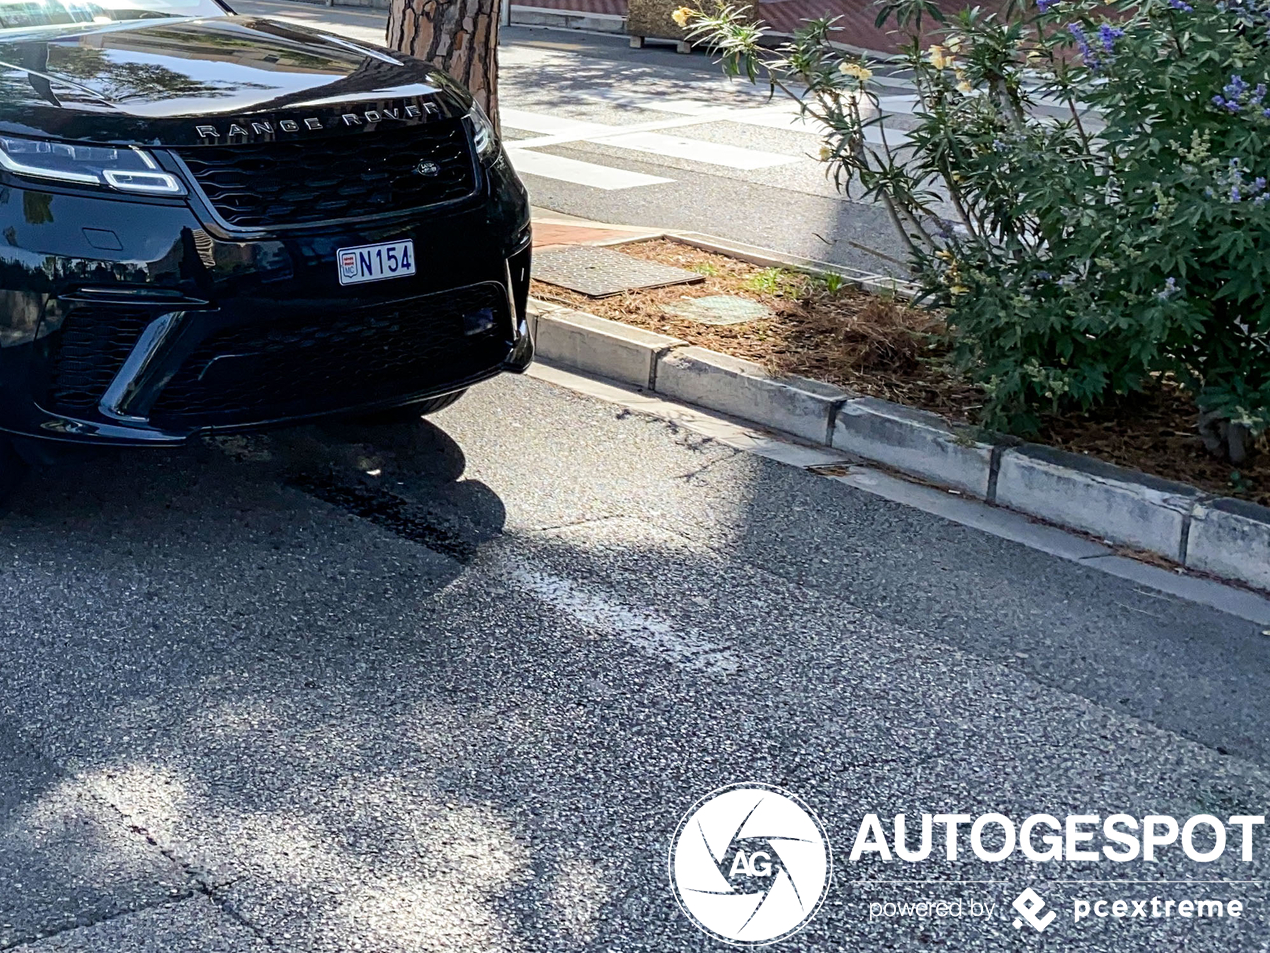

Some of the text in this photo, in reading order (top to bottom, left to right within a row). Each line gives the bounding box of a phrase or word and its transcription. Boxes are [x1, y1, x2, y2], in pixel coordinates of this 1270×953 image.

[195, 101, 440, 138] RANGE ROVER
[359, 245, 411, 277] N154
